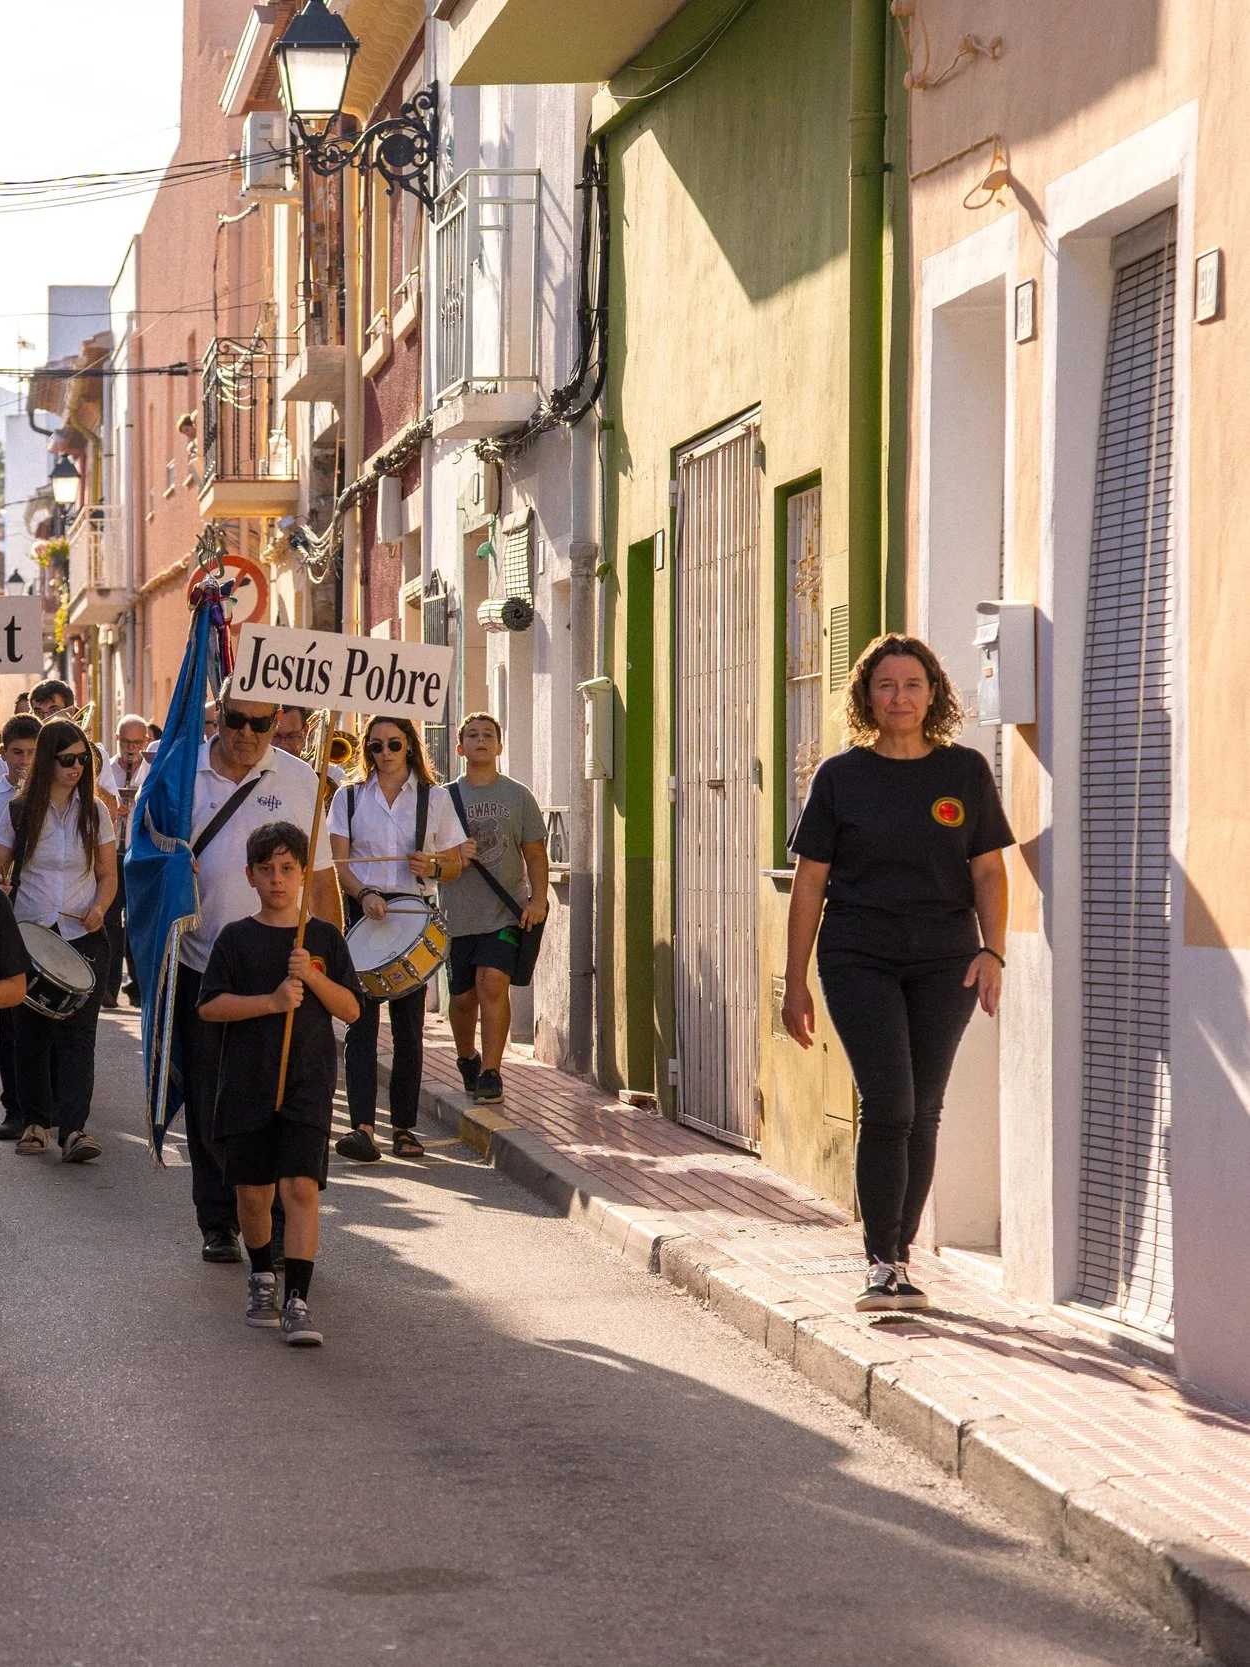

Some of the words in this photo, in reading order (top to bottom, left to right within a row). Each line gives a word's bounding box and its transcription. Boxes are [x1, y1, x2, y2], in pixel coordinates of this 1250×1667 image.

[239, 635, 333, 695] Jesús
[340, 647, 443, 707] Pobre
[464, 802, 511, 820] GWARTS
